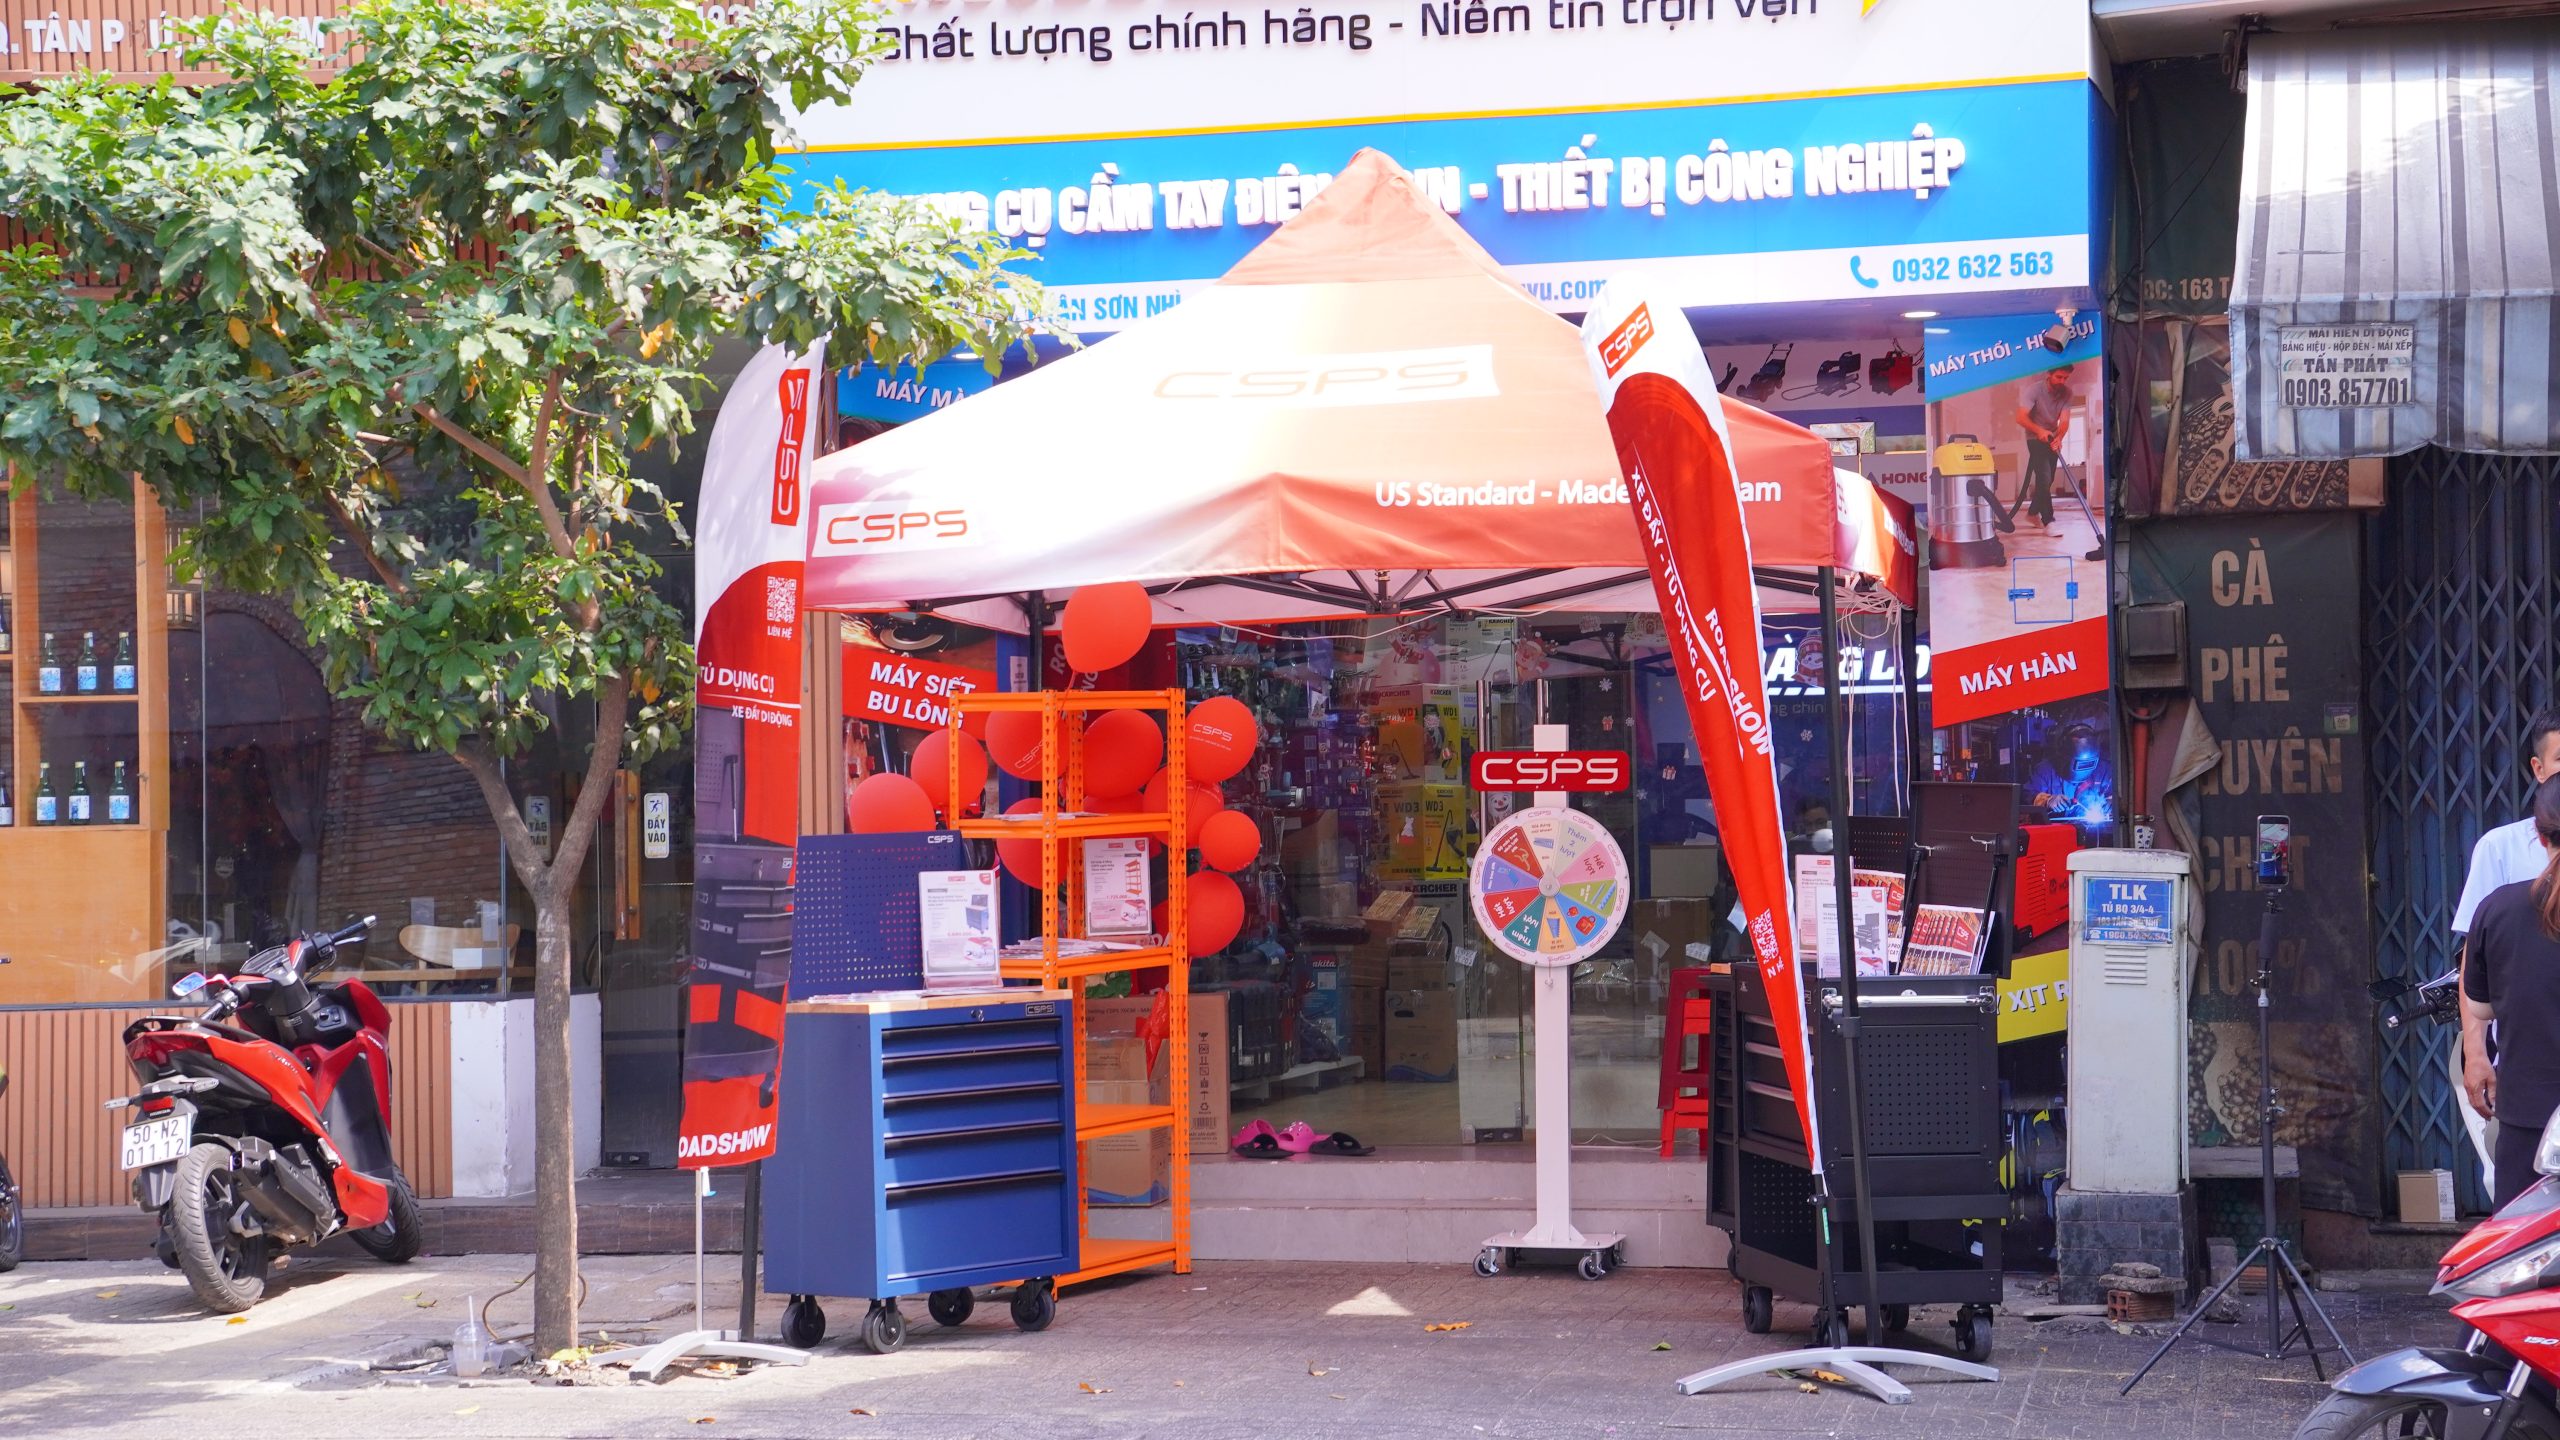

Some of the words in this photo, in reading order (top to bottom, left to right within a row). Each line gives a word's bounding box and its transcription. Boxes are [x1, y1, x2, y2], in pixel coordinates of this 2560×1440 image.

[24, 11, 92, 53] TÂN
[875, 16, 974, 60] Chất
[991, 22, 1112, 62] lượng
[1129, 12, 1246, 50] chính
[1264, 8, 1372, 50] hãng
[1549, 0, 1602, 29] tin
[1622, 0, 1714, 31] trọn
[1739, 0, 1817, 24] vẹn
[994, 187, 1052, 247] CỤ
[1058, 162, 1154, 234] CẦM
[1159, 179, 1229, 229] TAY
[1413, 158, 1461, 214] IN
[1497, 133, 1614, 213] THIẾT
[1621, 156, 1667, 216] BỊ
[1676, 137, 1795, 206] CÔNG
[1804, 122, 1966, 200] NGHIỆP
[1892, 258, 1949, 284] 0932
[1958, 254, 2004, 280] 632
[2009, 250, 2054, 276] 563
[2180, 278, 2214, 300] 163
[1056, 293, 1087, 321] ÂN
[1094, 293, 1139, 320] SƠN
[1603, 309, 1650, 370] CSPS
[2282, 341, 2305, 352] BẢNG
[2306, 341, 2326, 352] HIỆU
[2333, 340, 2351, 352] HỘP
[2377, 327, 2410, 339] ĐỘNG
[1929, 354, 1966, 378] MÁY
[2025, 329, 2048, 351] HÚ
[2343, 353, 2389, 373] PHÁT
[876, 378, 927, 405] MÁY
[930, 385, 974, 407] MÀ
[1153, 360, 1470, 399] CSPS
[2284, 377, 2409, 407] 0903.857701
[777, 377, 806, 517] CSPS
[1375, 480, 1412, 507] US
[1416, 480, 1536, 507] Standard
[1558, 477, 1631, 505] Made
[827, 509, 968, 545] CSPS
[1631, 465, 1646, 503] XE
[1696, 667, 1717, 703] CỤ
[2211, 537, 2275, 607] CÀ
[718, 667, 759, 693] DỤNG
[760, 674, 775, 699] CỤ
[869, 661, 922, 690] MÁY
[924, 674, 977, 699] SIẾT
[1704, 607, 1770, 756] ROADSHOW
[1959, 658, 2014, 697] MÁY
[2020, 650, 2079, 683] HÀN
[2201, 634, 2291, 703] PHÊ
[732, 704, 745, 719] XE
[770, 710, 793, 729] ĐỘNG
[867, 690, 900, 715] BU
[1193, 723, 1233, 742] CSPS
[1480, 757, 1619, 785] CSPS
[647, 829, 666, 843] VÀO
[927, 834, 954, 844] CSPS
[1567, 827, 1588, 843] Thêm
[2202, 835, 2311, 893] CHT
[2108, 883, 2148, 901] TLK
[2101, 901, 2114, 913] TỦ
[2115, 903, 2129, 914] BQ
[2130, 904, 2155, 914] 3/4-4
[1027, 1002, 1054, 1014] CSPS
[2007, 983, 2049, 1013] XỊT
[126, 1138, 185, 1167] 011.12
[678, 1123, 772, 1159] OADSHOW
